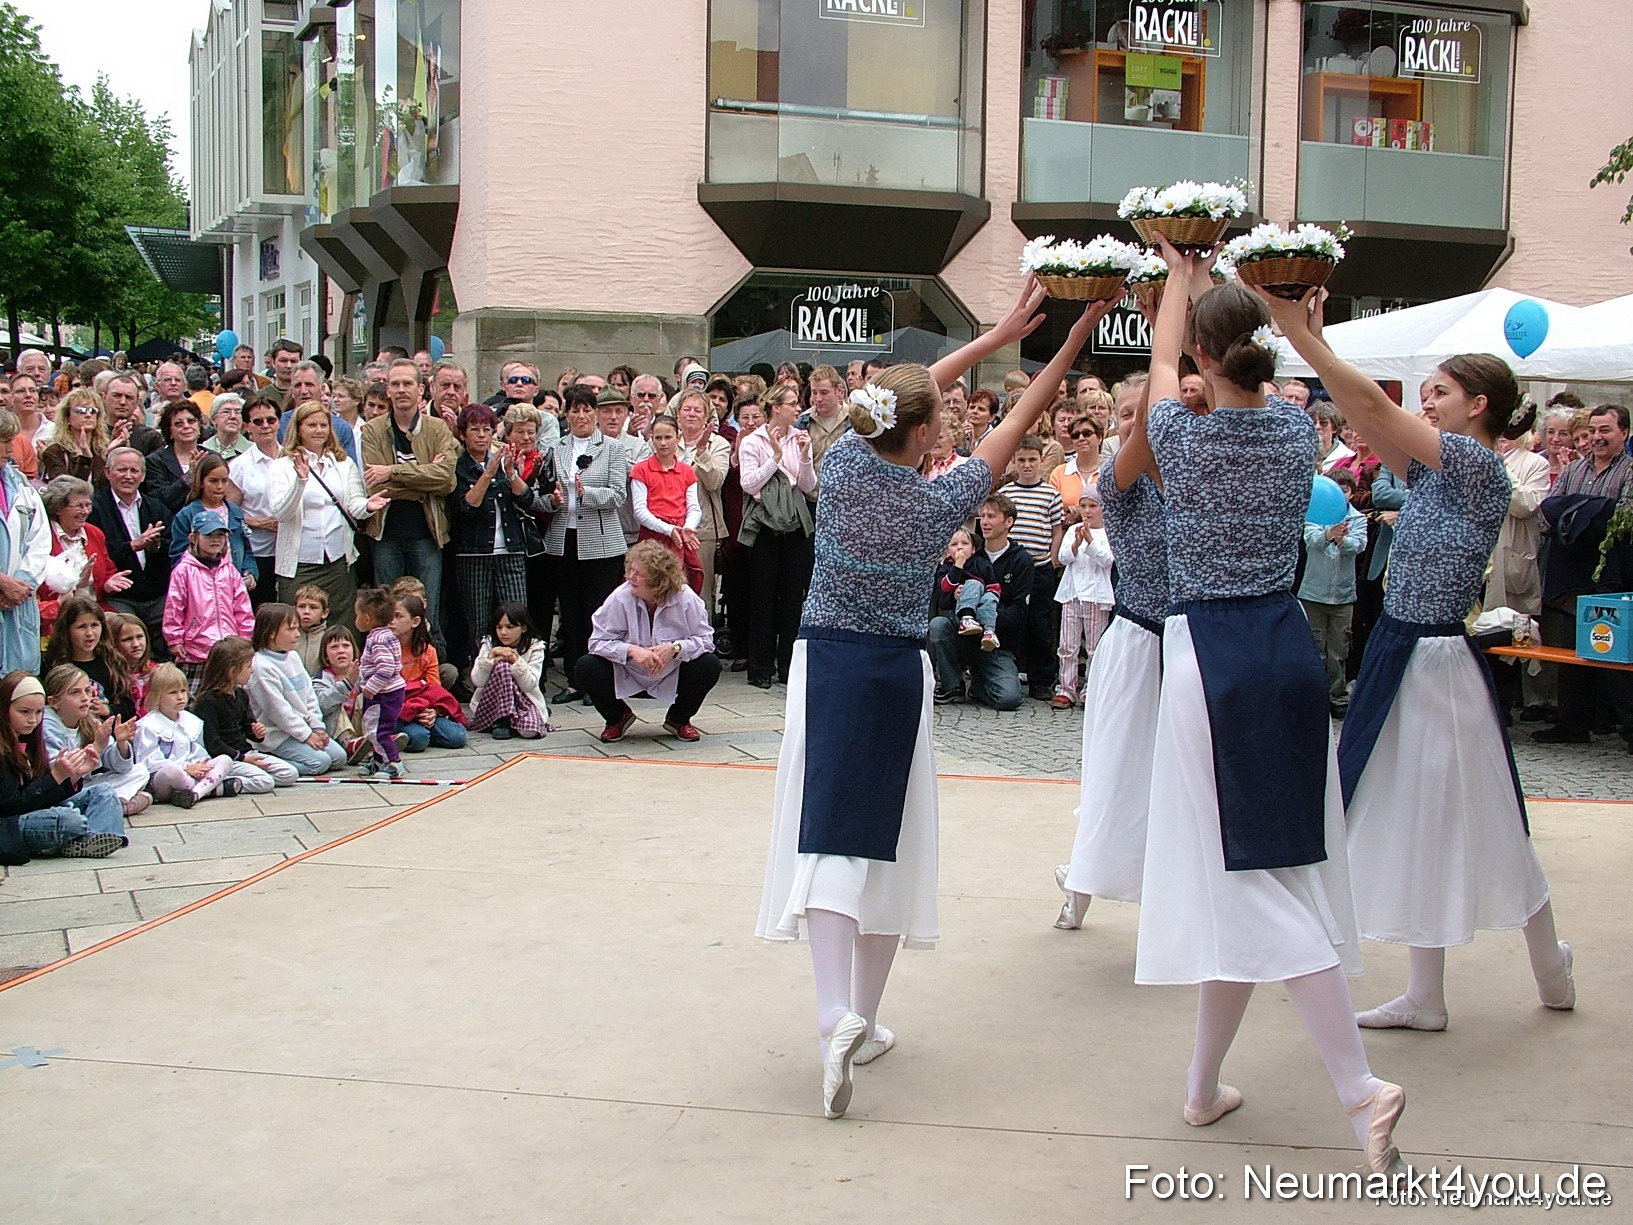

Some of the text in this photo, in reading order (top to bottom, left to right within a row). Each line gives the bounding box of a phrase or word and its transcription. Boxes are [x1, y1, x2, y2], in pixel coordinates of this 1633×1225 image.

[1135, 6, 1198, 46] RACKL
[1410, 18, 1471, 35] 100 Jahre
[1404, 36, 1460, 73] RACKL
[805, 284, 880, 303] 100 Jahre
[797, 305, 867, 343] RACKL
